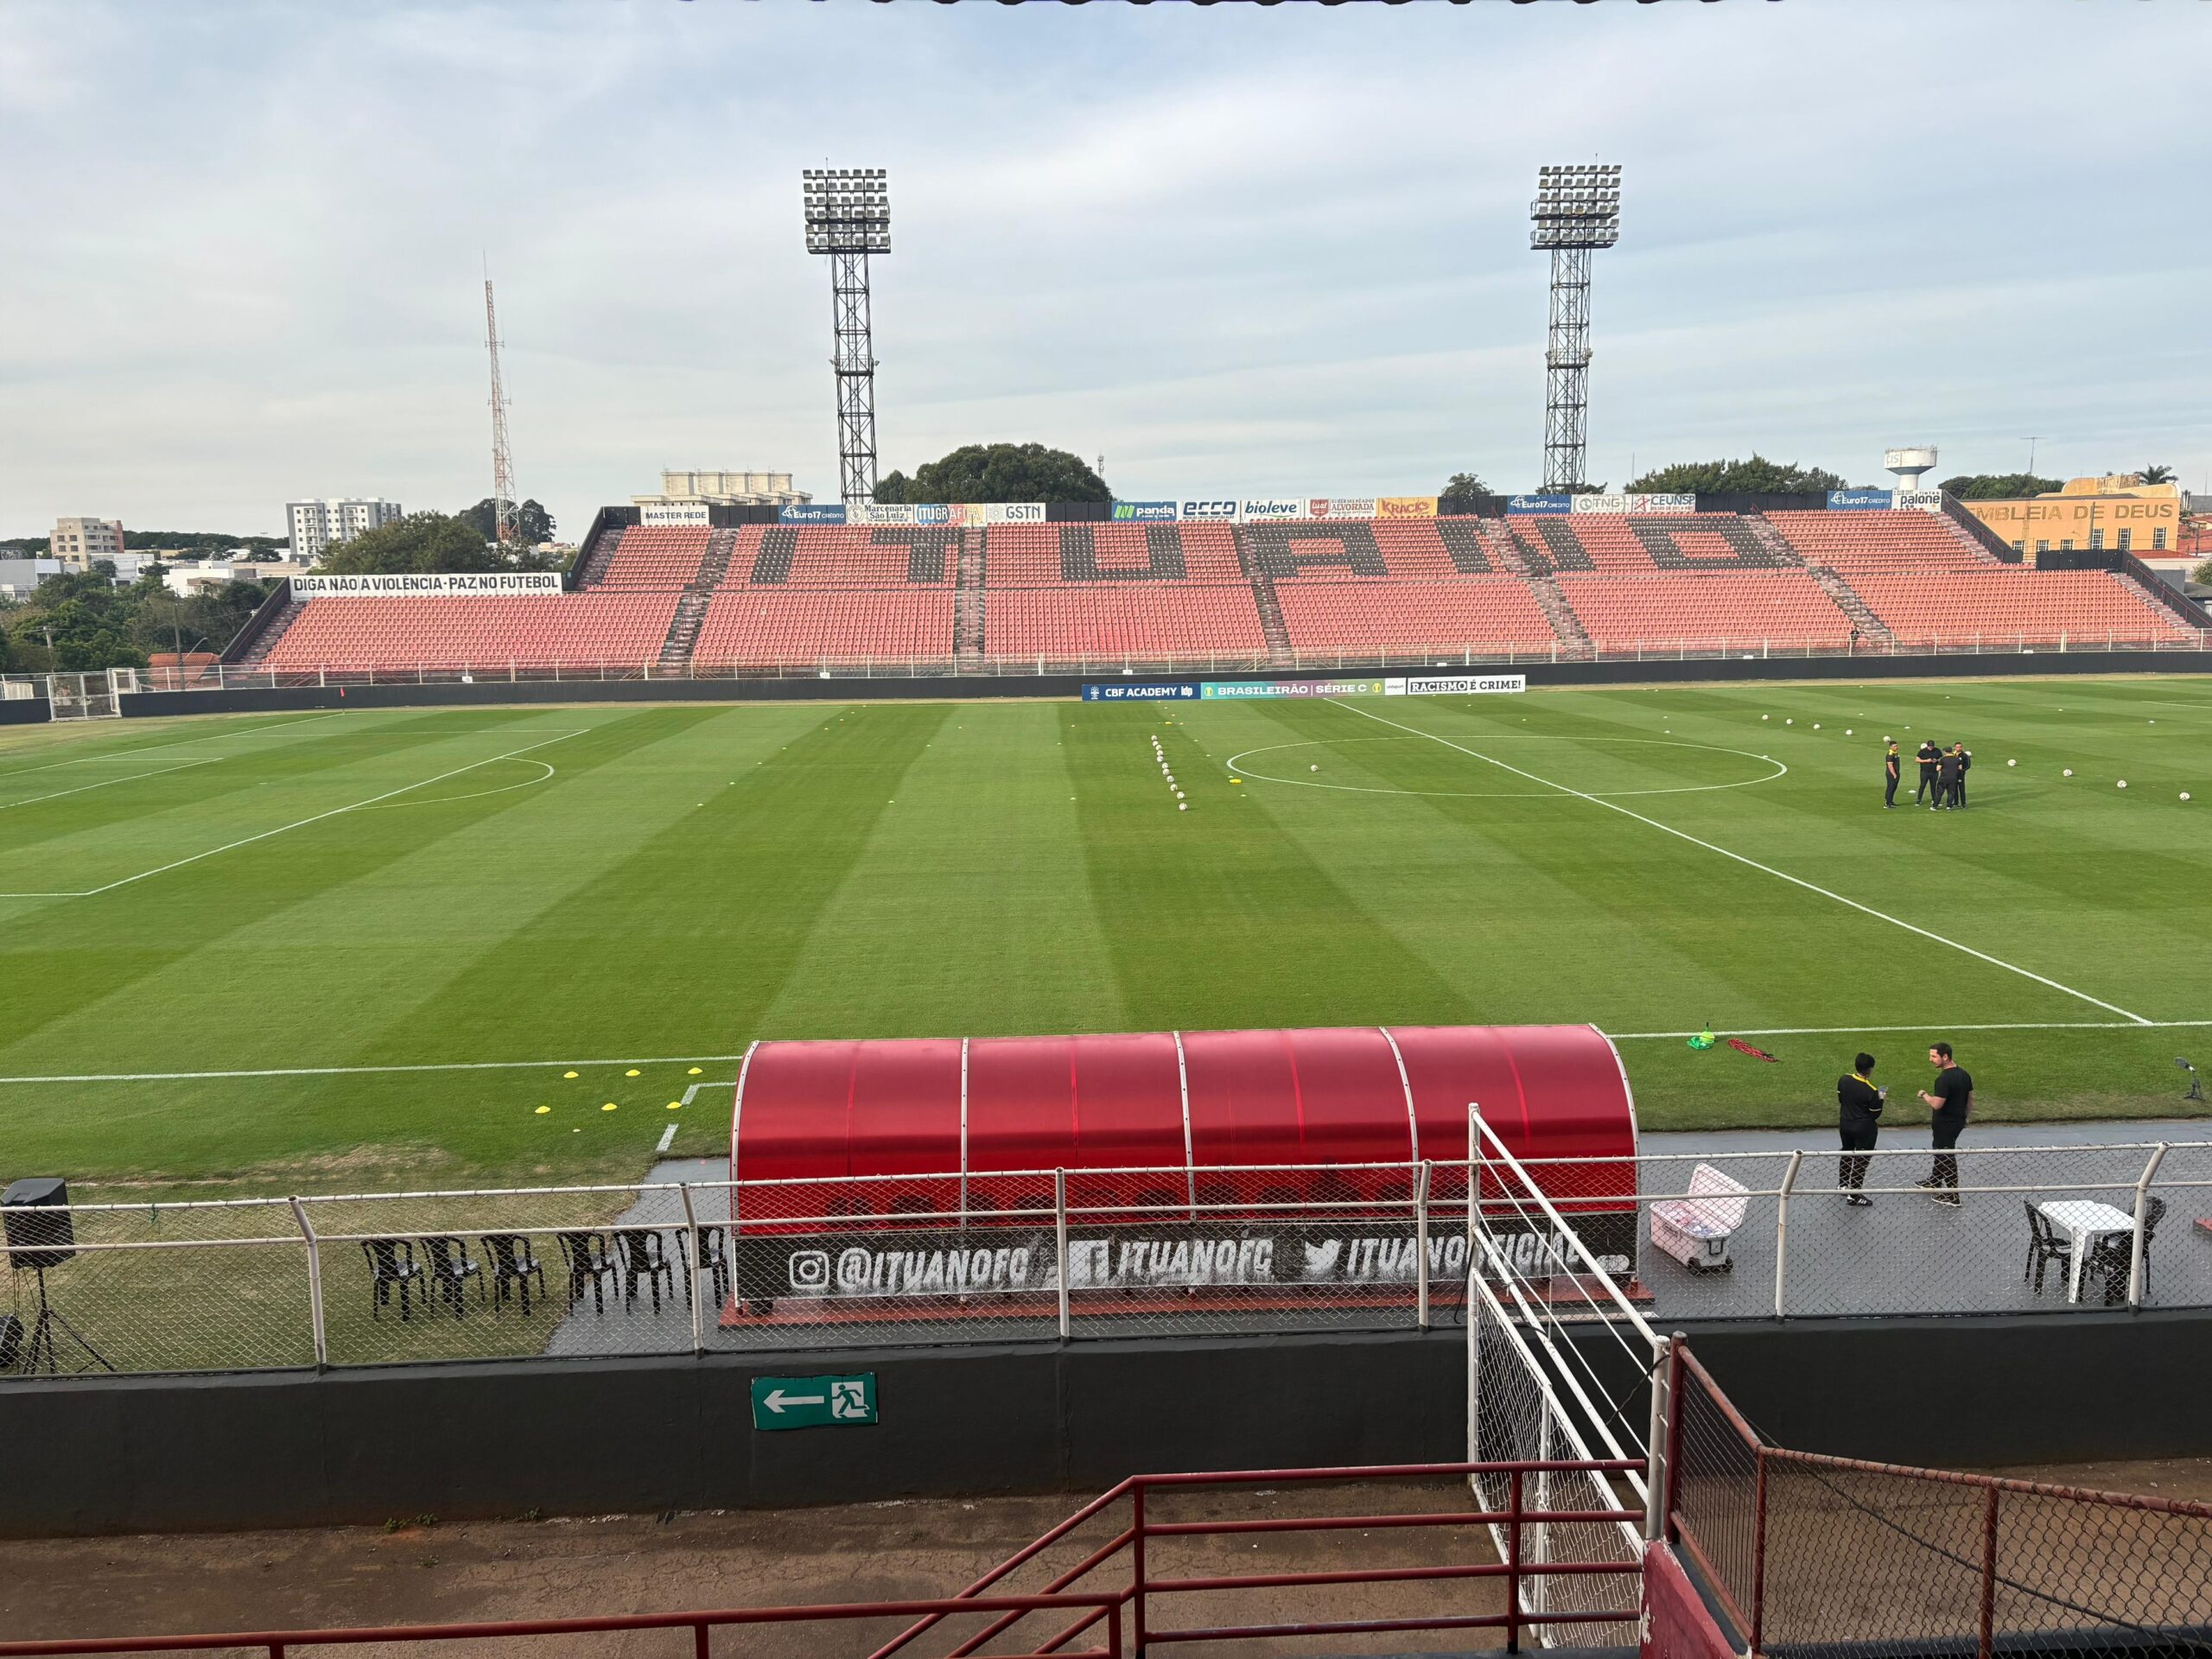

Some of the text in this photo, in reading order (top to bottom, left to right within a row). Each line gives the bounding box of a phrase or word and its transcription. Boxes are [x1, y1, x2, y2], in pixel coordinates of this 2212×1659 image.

[1245, 500, 1297, 514] bioleve
[1593, 498, 1620, 508] TNG
[1651, 495, 1695, 505] CEUNSP
[1841, 496, 1869, 505] Euro17
[1900, 493, 1941, 508] palone
[793, 510, 822, 519] Euro17
[1006, 505, 1040, 519] GSTN
[1136, 505, 1175, 518] panda
[1183, 501, 1236, 516] ecco
[1331, 503, 1375, 512] ALVORADA
[1382, 500, 1430, 517] KRACKS
[2074, 505, 2105, 519] DE
[2115, 504, 2173, 519] DEUS
[683, 511, 707, 519] REDE
[294, 578, 327, 591] DIGA
[329, 575, 358, 591] NÃO
[372, 575, 442, 590] VIOLÊNCIA
[448, 576, 478, 589] PAZ
[479, 576, 498, 589] NO
[499, 575, 559, 589] FUTEBOL
[1105, 686, 1178, 697] CBF ACADEMY
[1217, 683, 1308, 696] BRASILEIRÃO
[1315, 683, 1367, 693] SÉRIE C
[1411, 678, 1522, 692] RACISMO É CRIME!
[1117, 1239, 1274, 1278] ITUANOFC
[1346, 1230, 1580, 1279] ITUANOFICIAL
[836, 1247, 1030, 1292] @ITUANOFC
